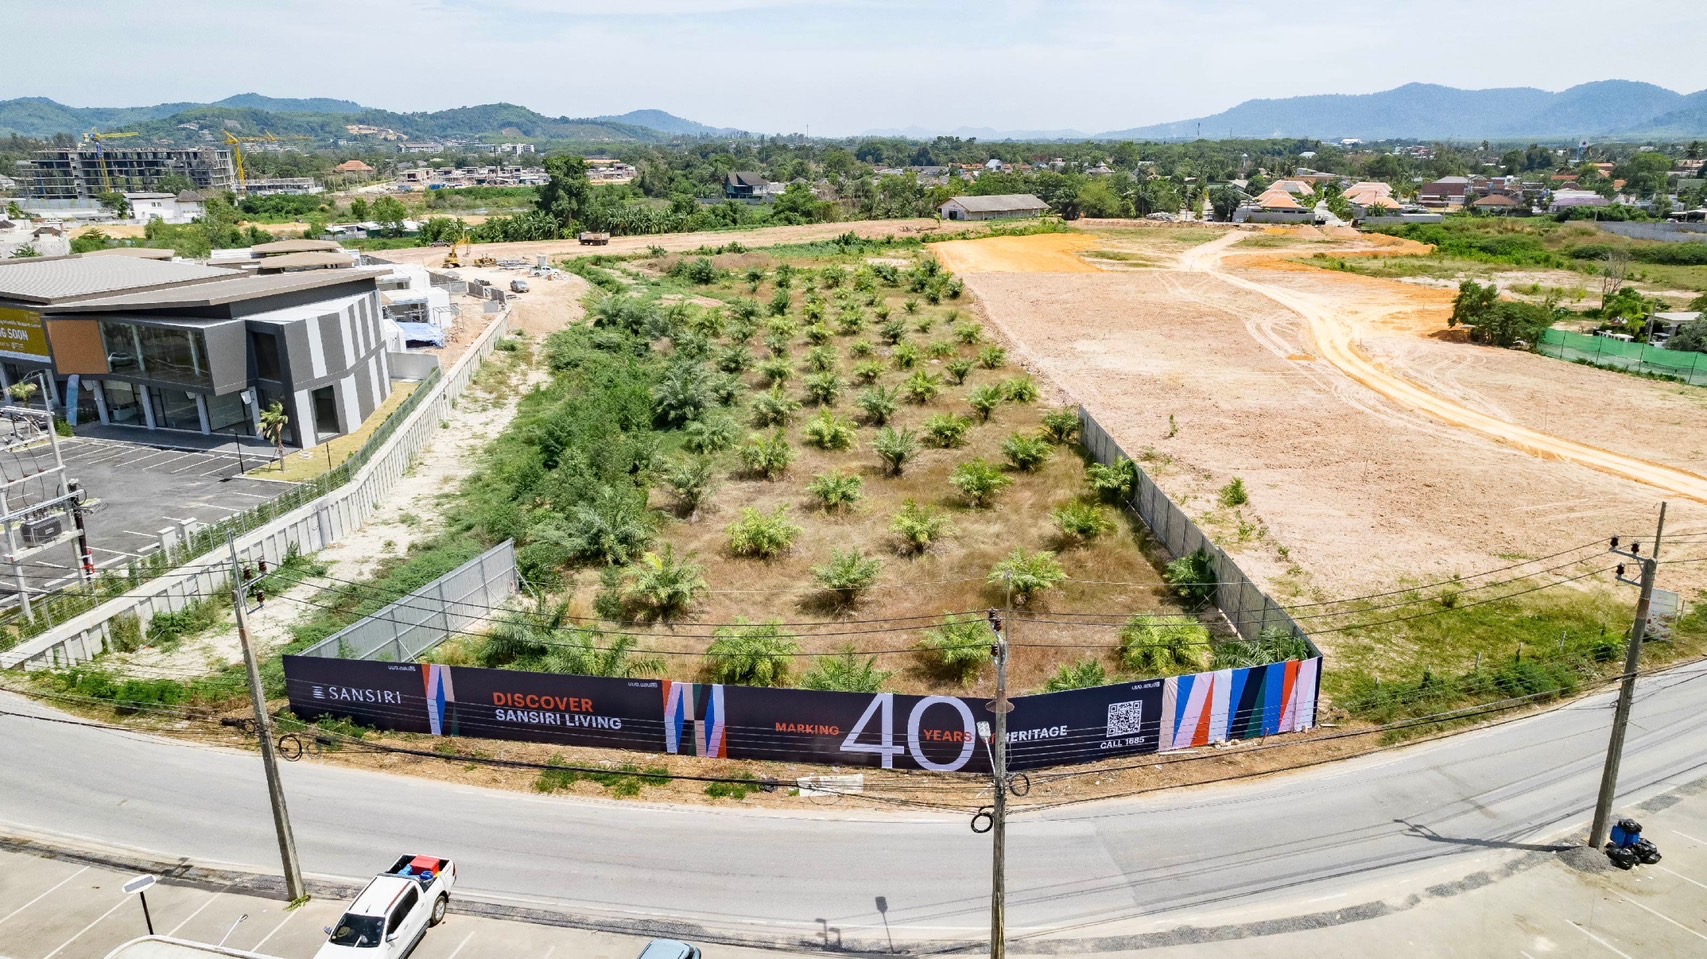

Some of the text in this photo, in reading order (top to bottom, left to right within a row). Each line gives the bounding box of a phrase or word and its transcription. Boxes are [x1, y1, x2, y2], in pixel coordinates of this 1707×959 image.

[8, 328, 29, 341] SOON
[329, 686, 402, 704] SANSIRI
[493, 692, 593, 713] DISCOVER
[495, 709, 622, 730] SANSIRI LIVING
[775, 722, 840, 736] MARKING
[840, 693, 976, 772] 40
[923, 729, 973, 742] YEARS
[1100, 736, 1145, 750] CALL 1685
